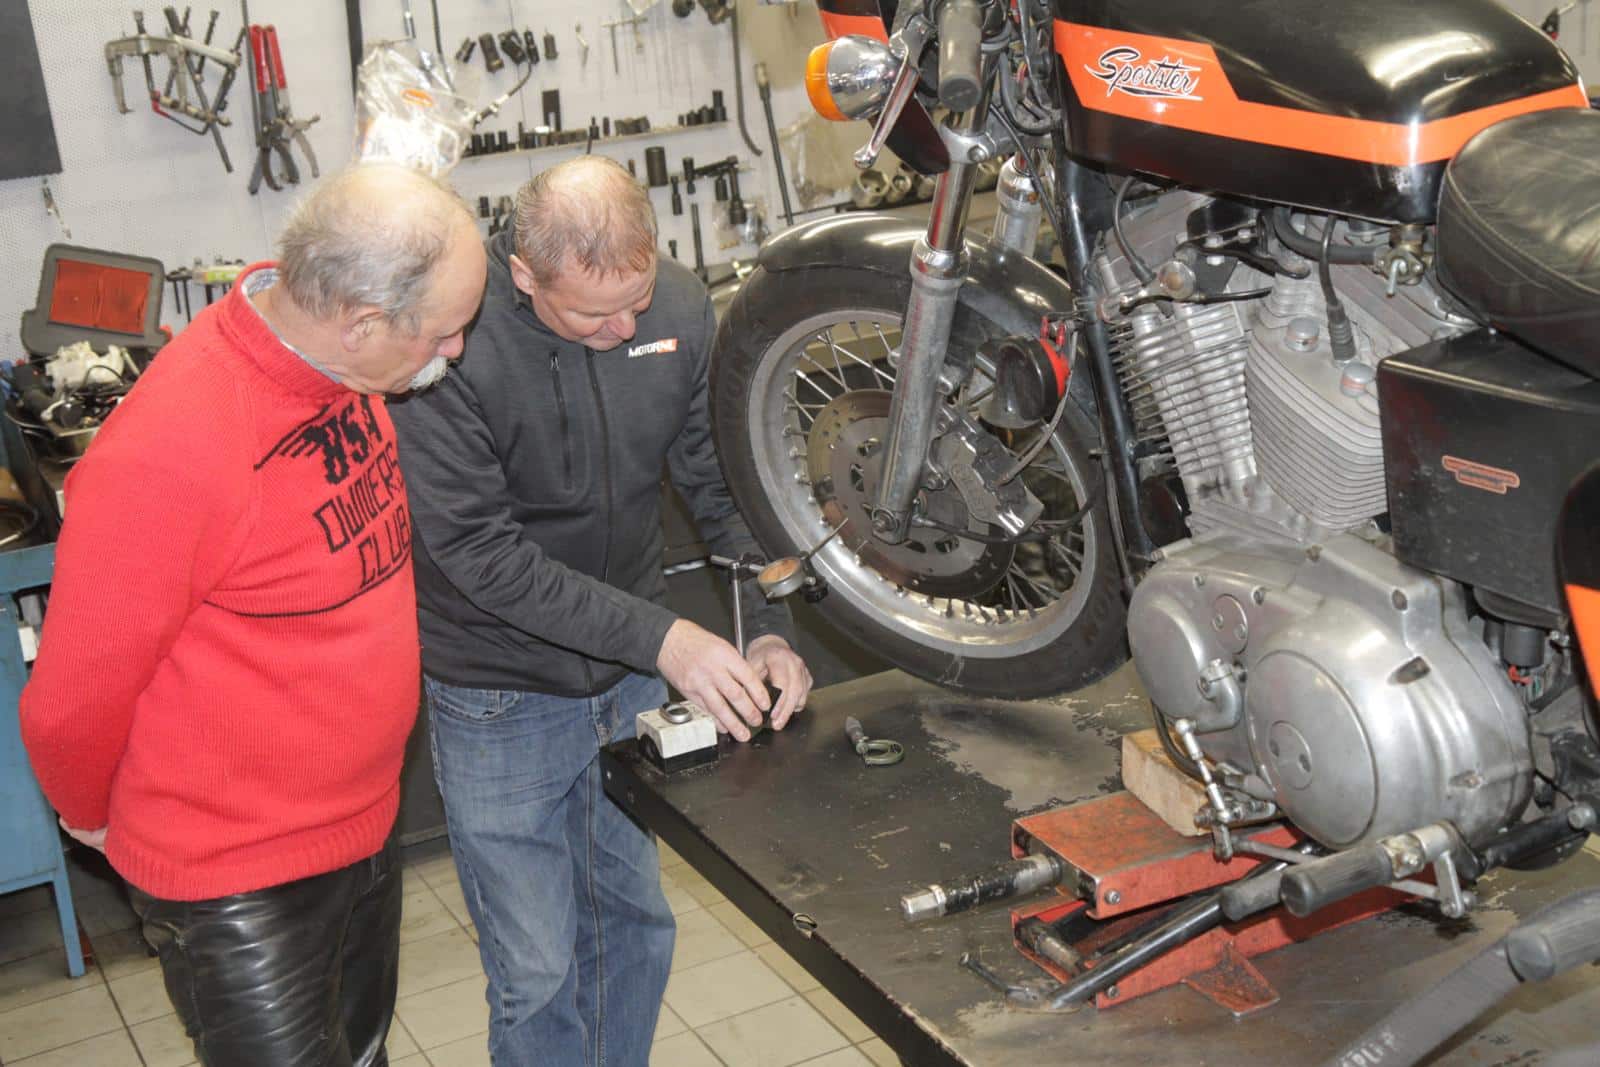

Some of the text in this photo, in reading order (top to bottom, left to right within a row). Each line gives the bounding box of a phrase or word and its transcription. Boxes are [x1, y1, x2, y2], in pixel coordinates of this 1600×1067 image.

[1084, 45, 1203, 101] Sportster
[323, 393, 382, 484] BSA
[357, 505, 411, 588] CLUB
